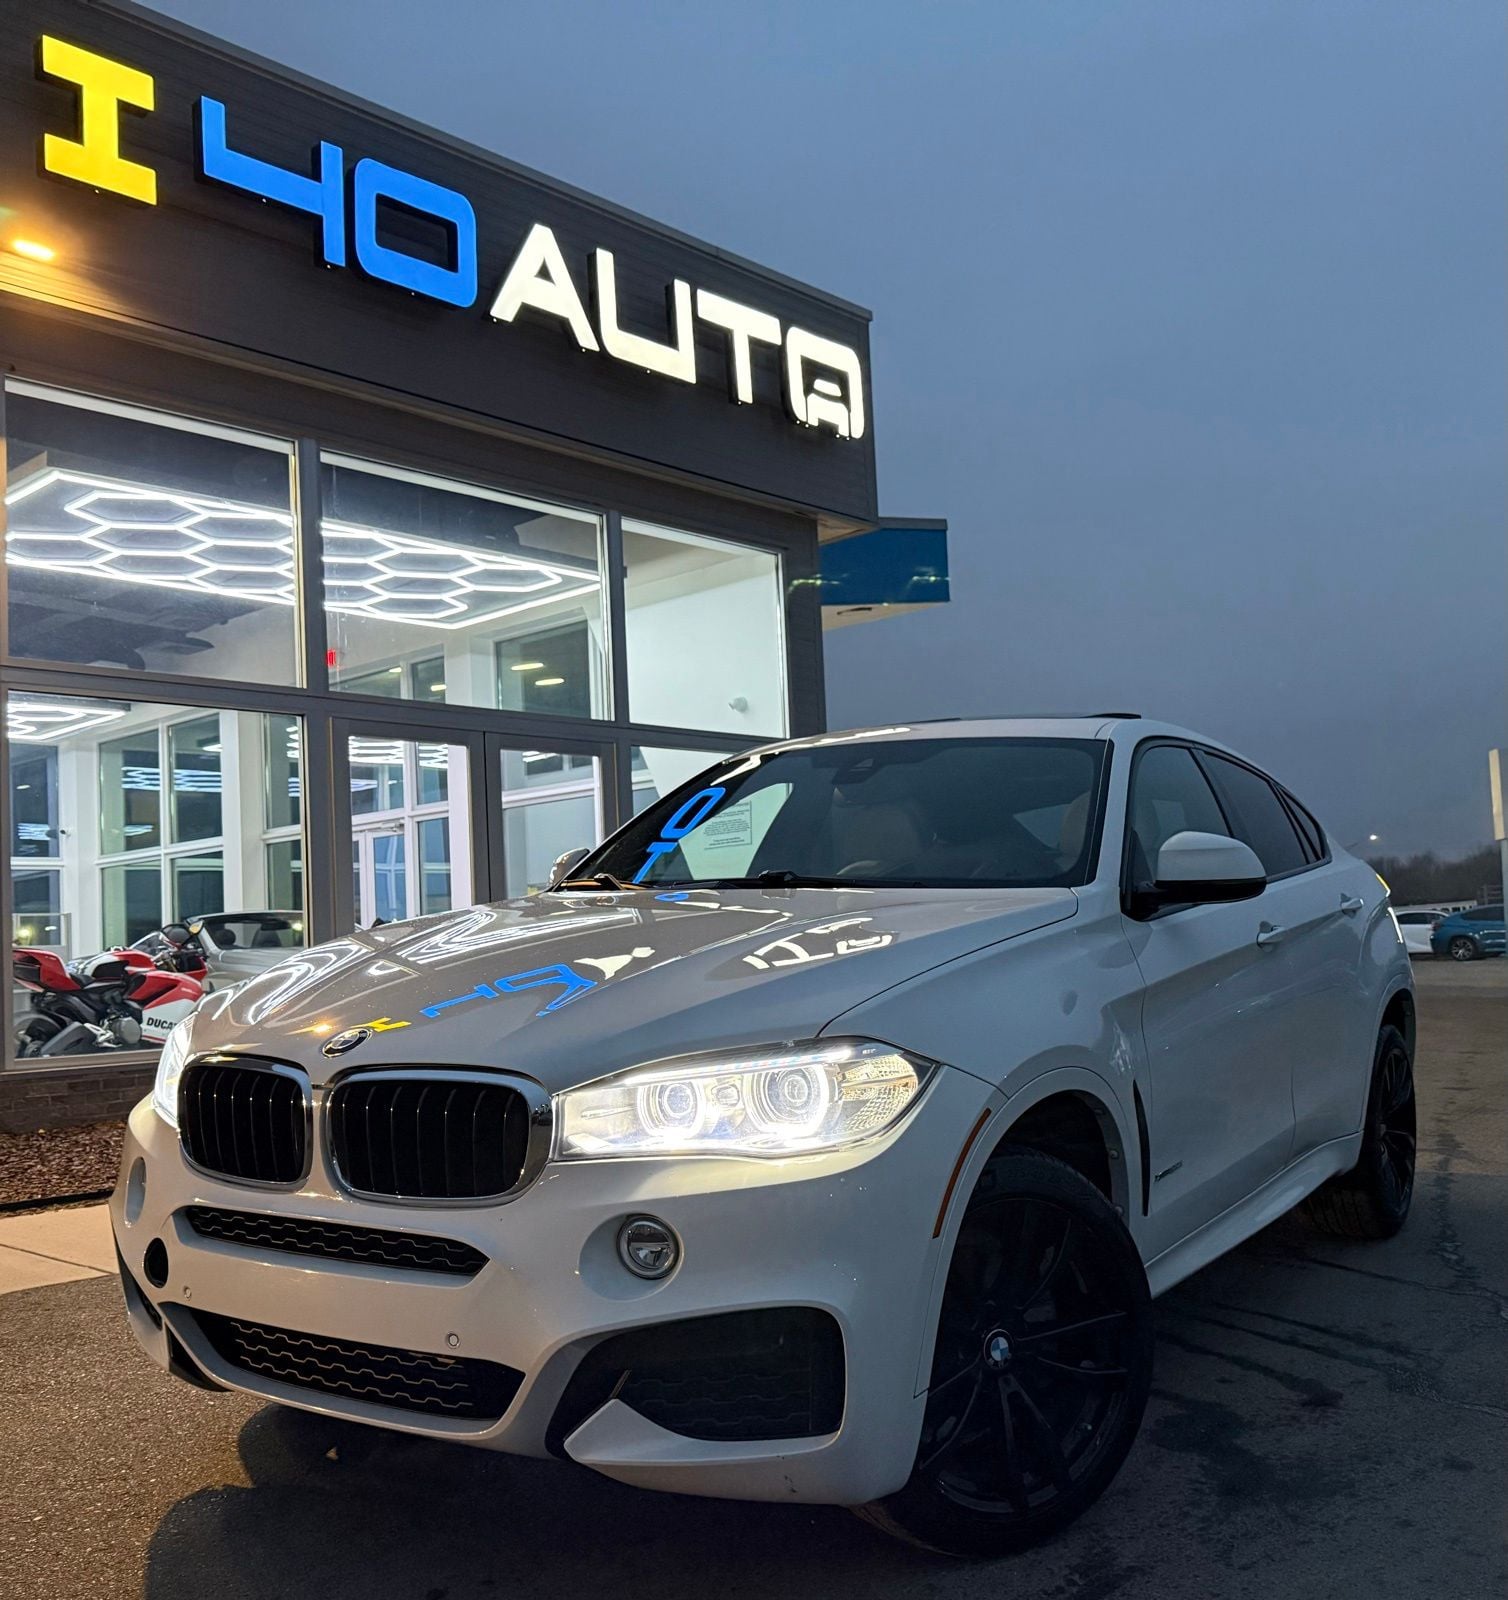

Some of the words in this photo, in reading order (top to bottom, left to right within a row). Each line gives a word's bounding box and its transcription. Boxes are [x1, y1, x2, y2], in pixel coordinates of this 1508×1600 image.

[41, 35, 157, 206] I
[201, 95, 478, 308] 40
[490, 223, 865, 440] AUTO
